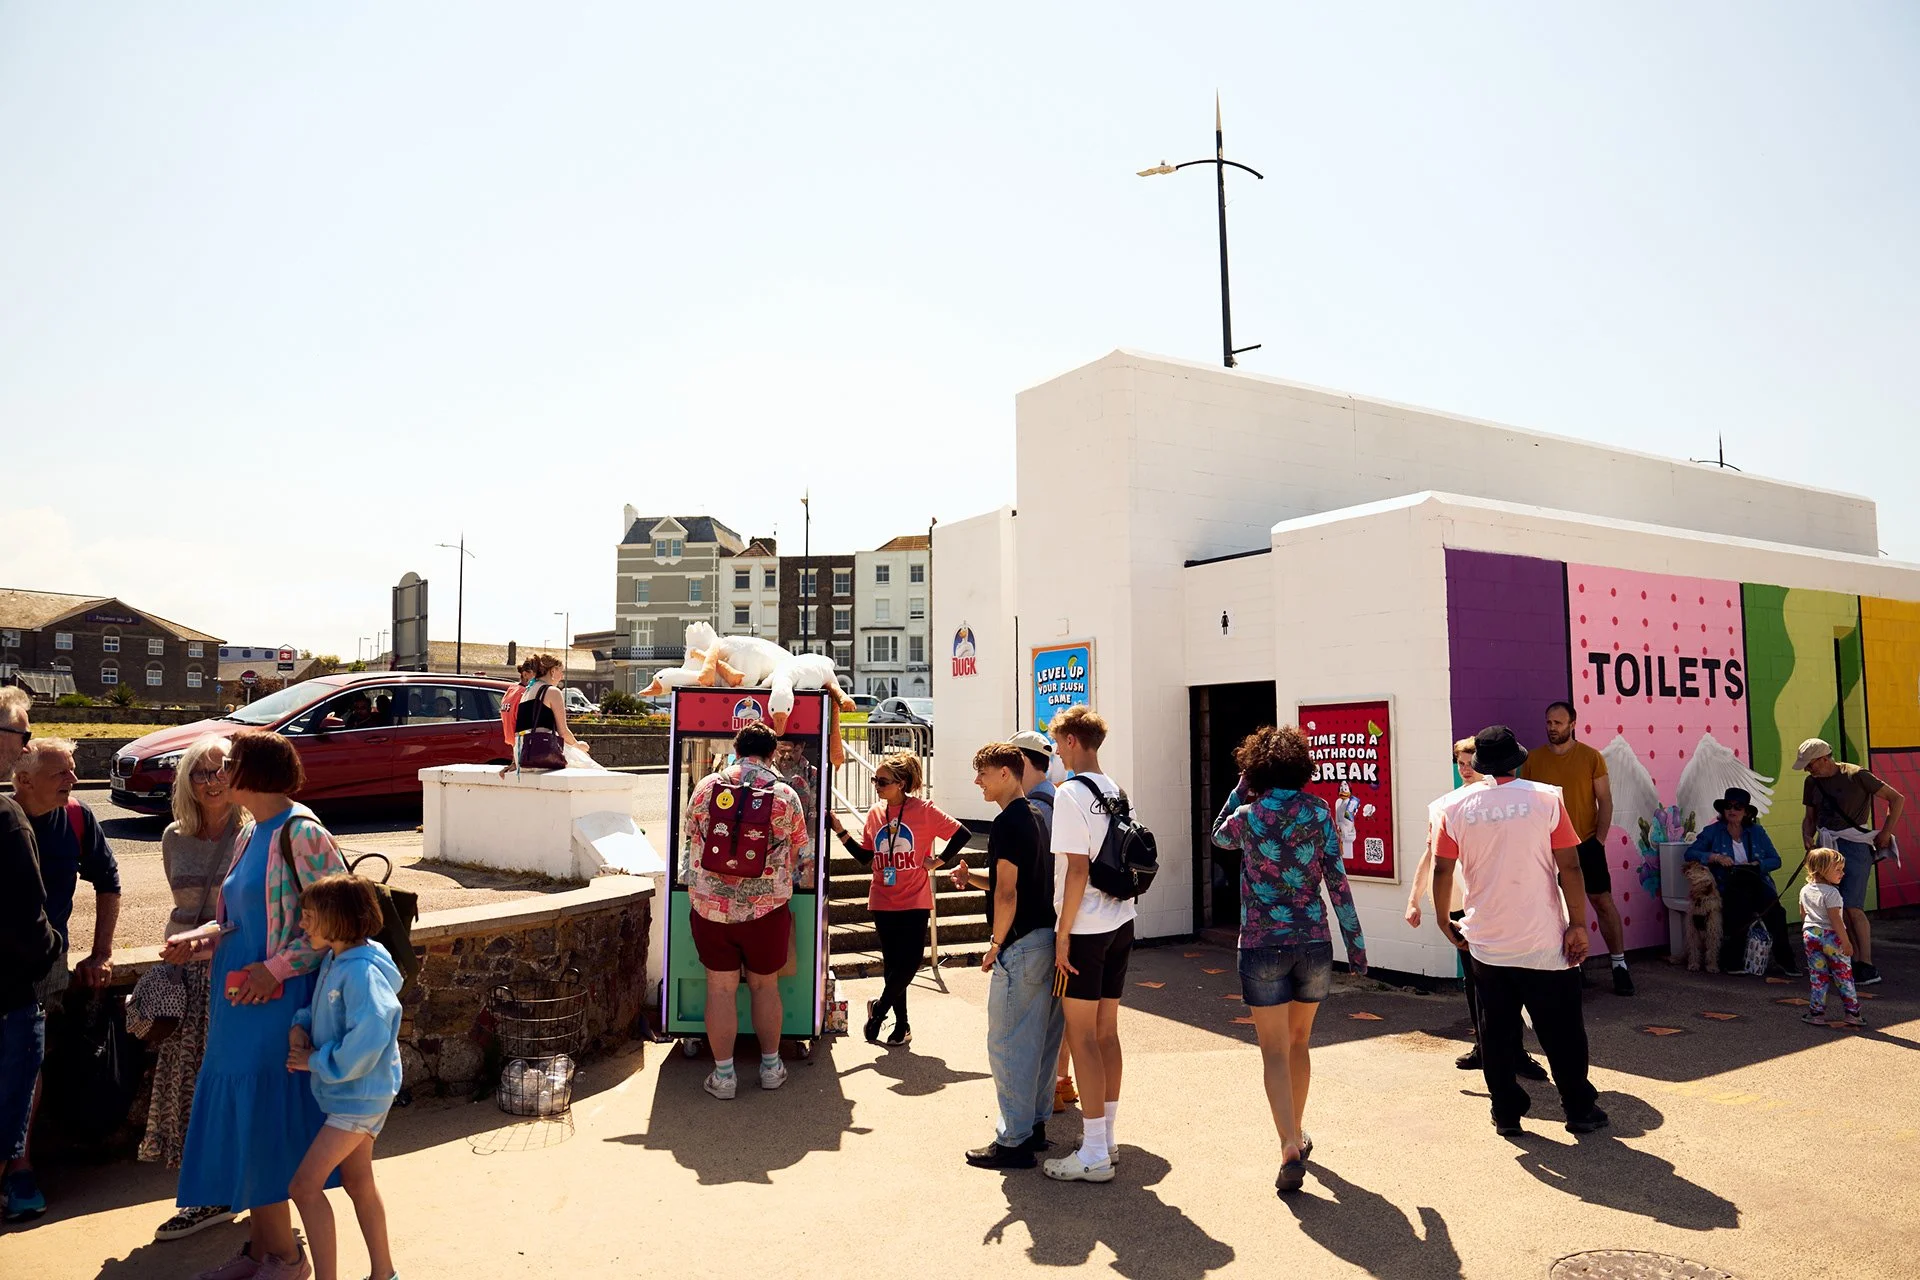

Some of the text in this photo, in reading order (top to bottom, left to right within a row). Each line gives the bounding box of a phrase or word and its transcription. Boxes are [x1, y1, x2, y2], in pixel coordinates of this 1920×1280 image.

[952, 656, 977, 677] DUCK
[1037, 666, 1084, 683] LEVEL UP
[1588, 652, 1744, 700] TOILETS
[1038, 682, 1084, 695] YOUR FLUSH
[1048, 694, 1072, 705] GAME
[1307, 733, 1378, 747] TIME FOR A
[1465, 803, 1529, 824] STAFF
